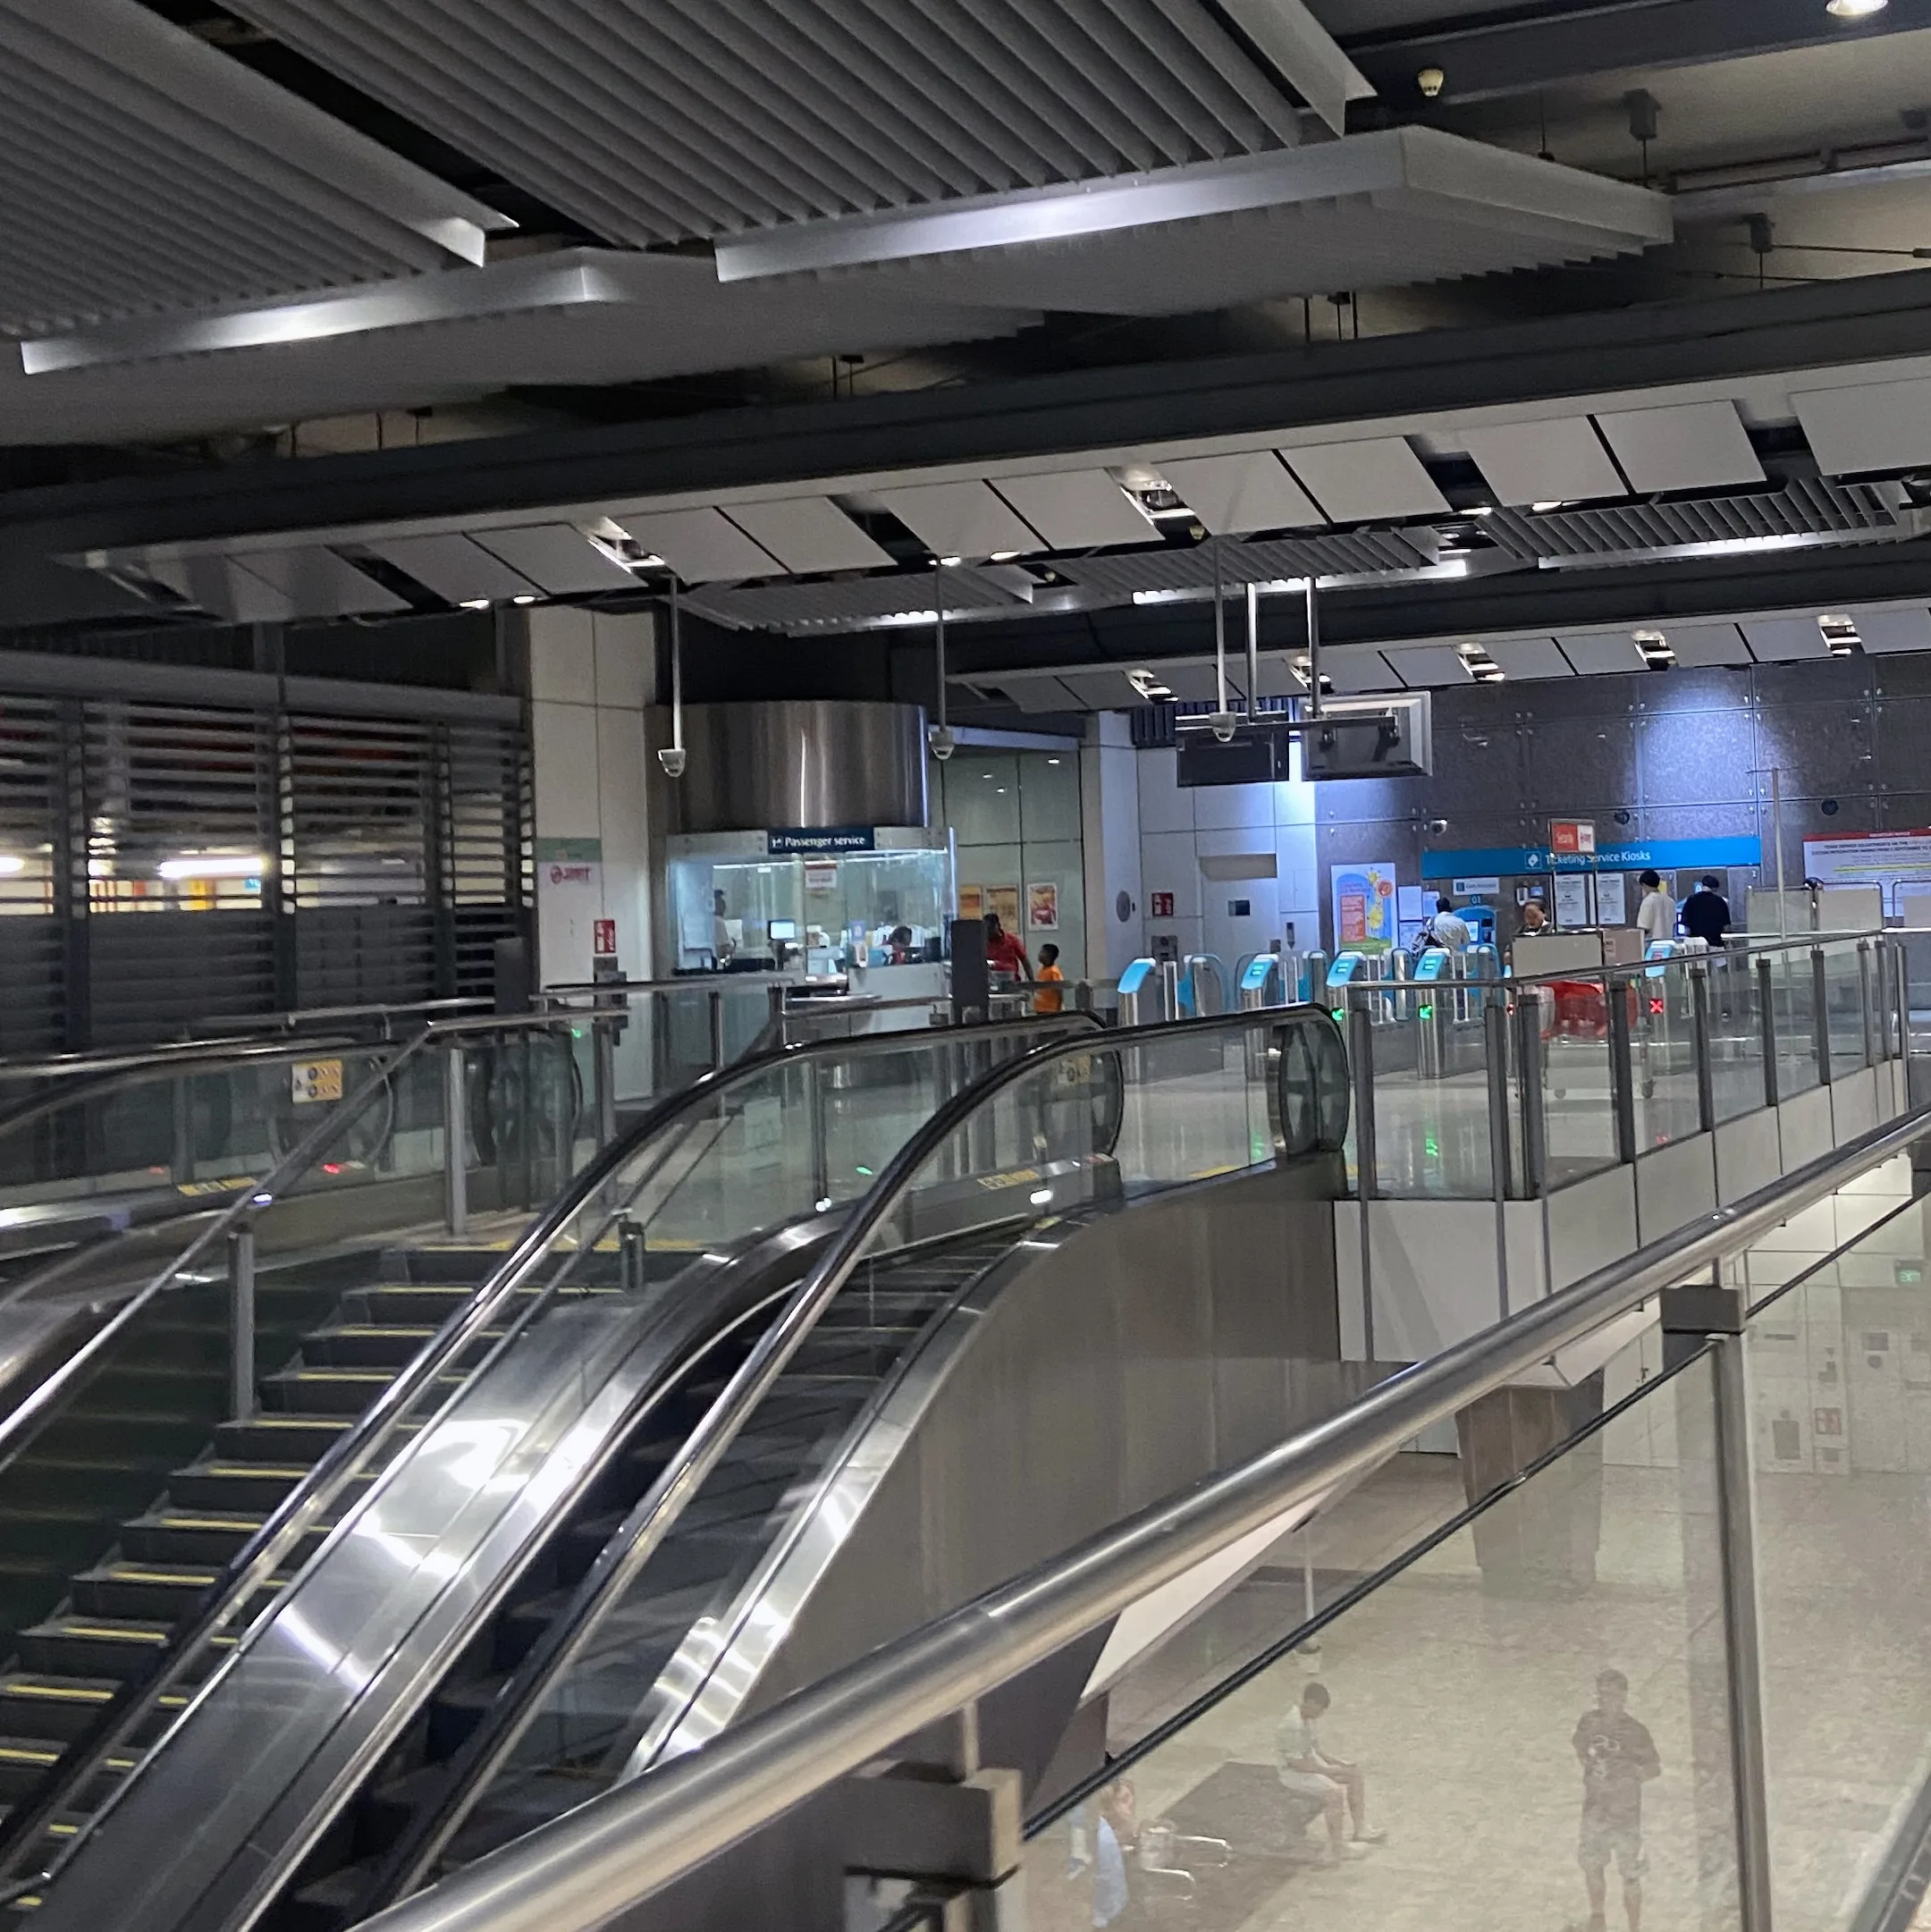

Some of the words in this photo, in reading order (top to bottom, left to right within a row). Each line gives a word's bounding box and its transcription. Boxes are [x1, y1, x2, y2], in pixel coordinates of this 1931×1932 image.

[785, 836, 831, 848] Passenger
[834, 836, 865, 845] service
[1622, 850, 1651, 862] Kiosks
[1471, 896, 1481, 904] 01
